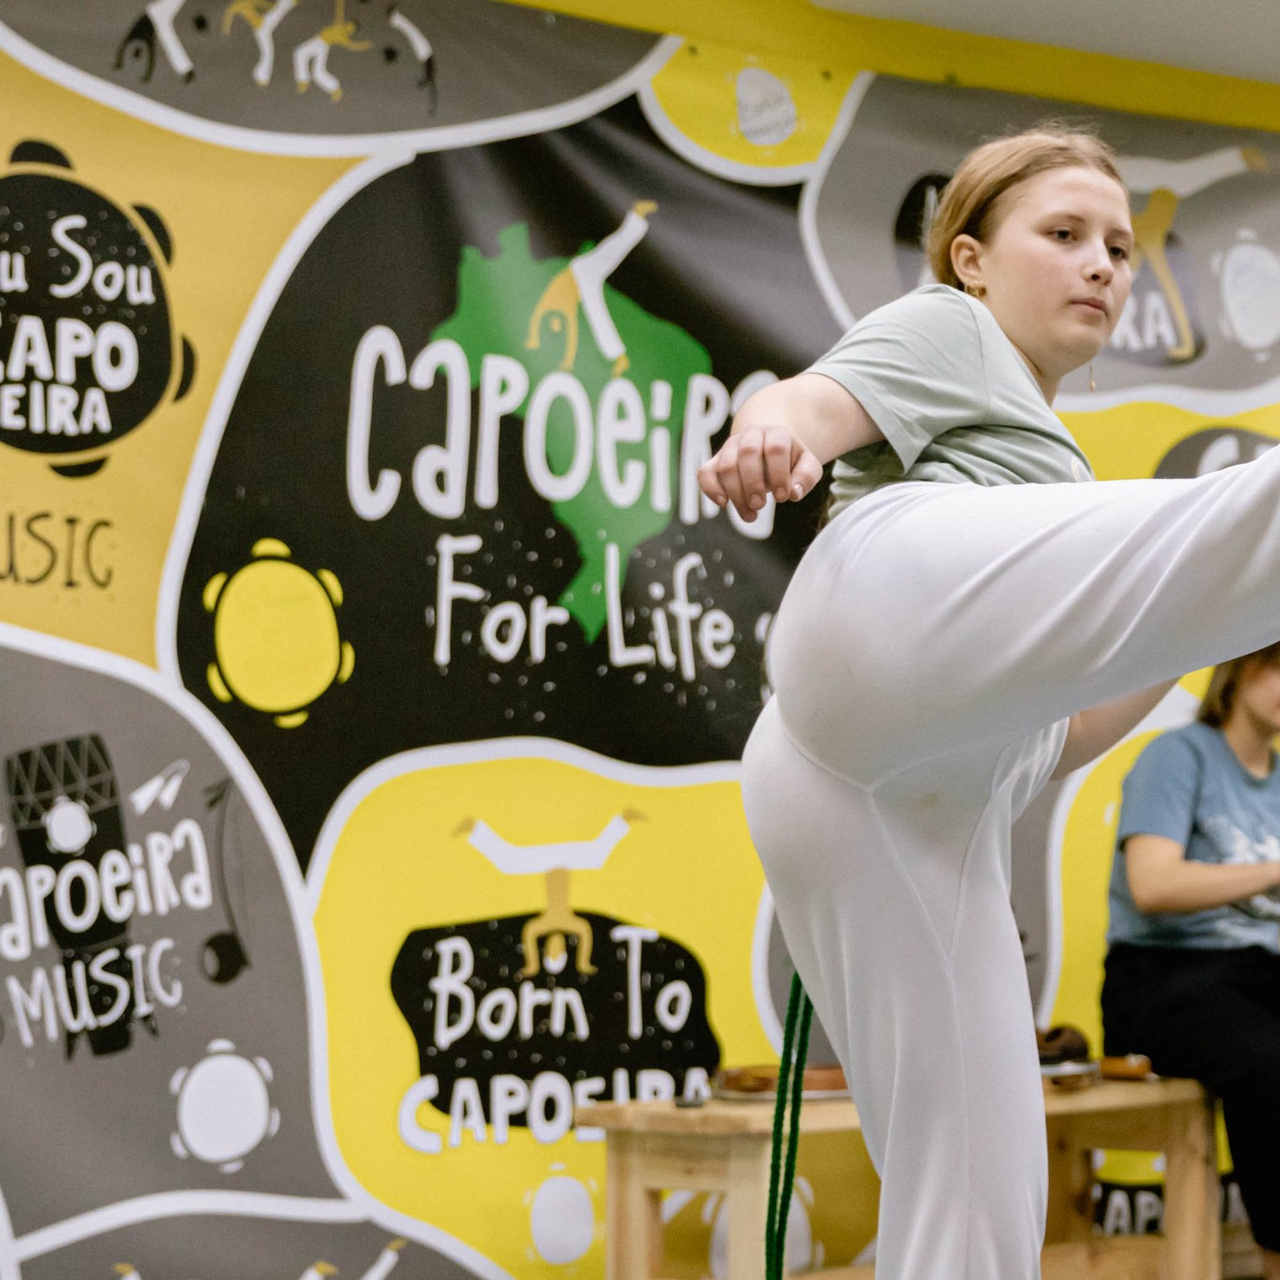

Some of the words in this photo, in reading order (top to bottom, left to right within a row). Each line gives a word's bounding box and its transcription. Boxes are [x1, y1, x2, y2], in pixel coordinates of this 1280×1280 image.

[0, 250, 29, 293] u
[49, 214, 156, 305] Sou
[0, 310, 140, 393] APO
[0, 380, 112, 436] EIRA
[0, 511, 114, 589] USIC
[434, 534, 571, 666] For
[605, 542, 736, 682] Life
[428, 936, 590, 1051] Born
[610, 925, 693, 1040] To
